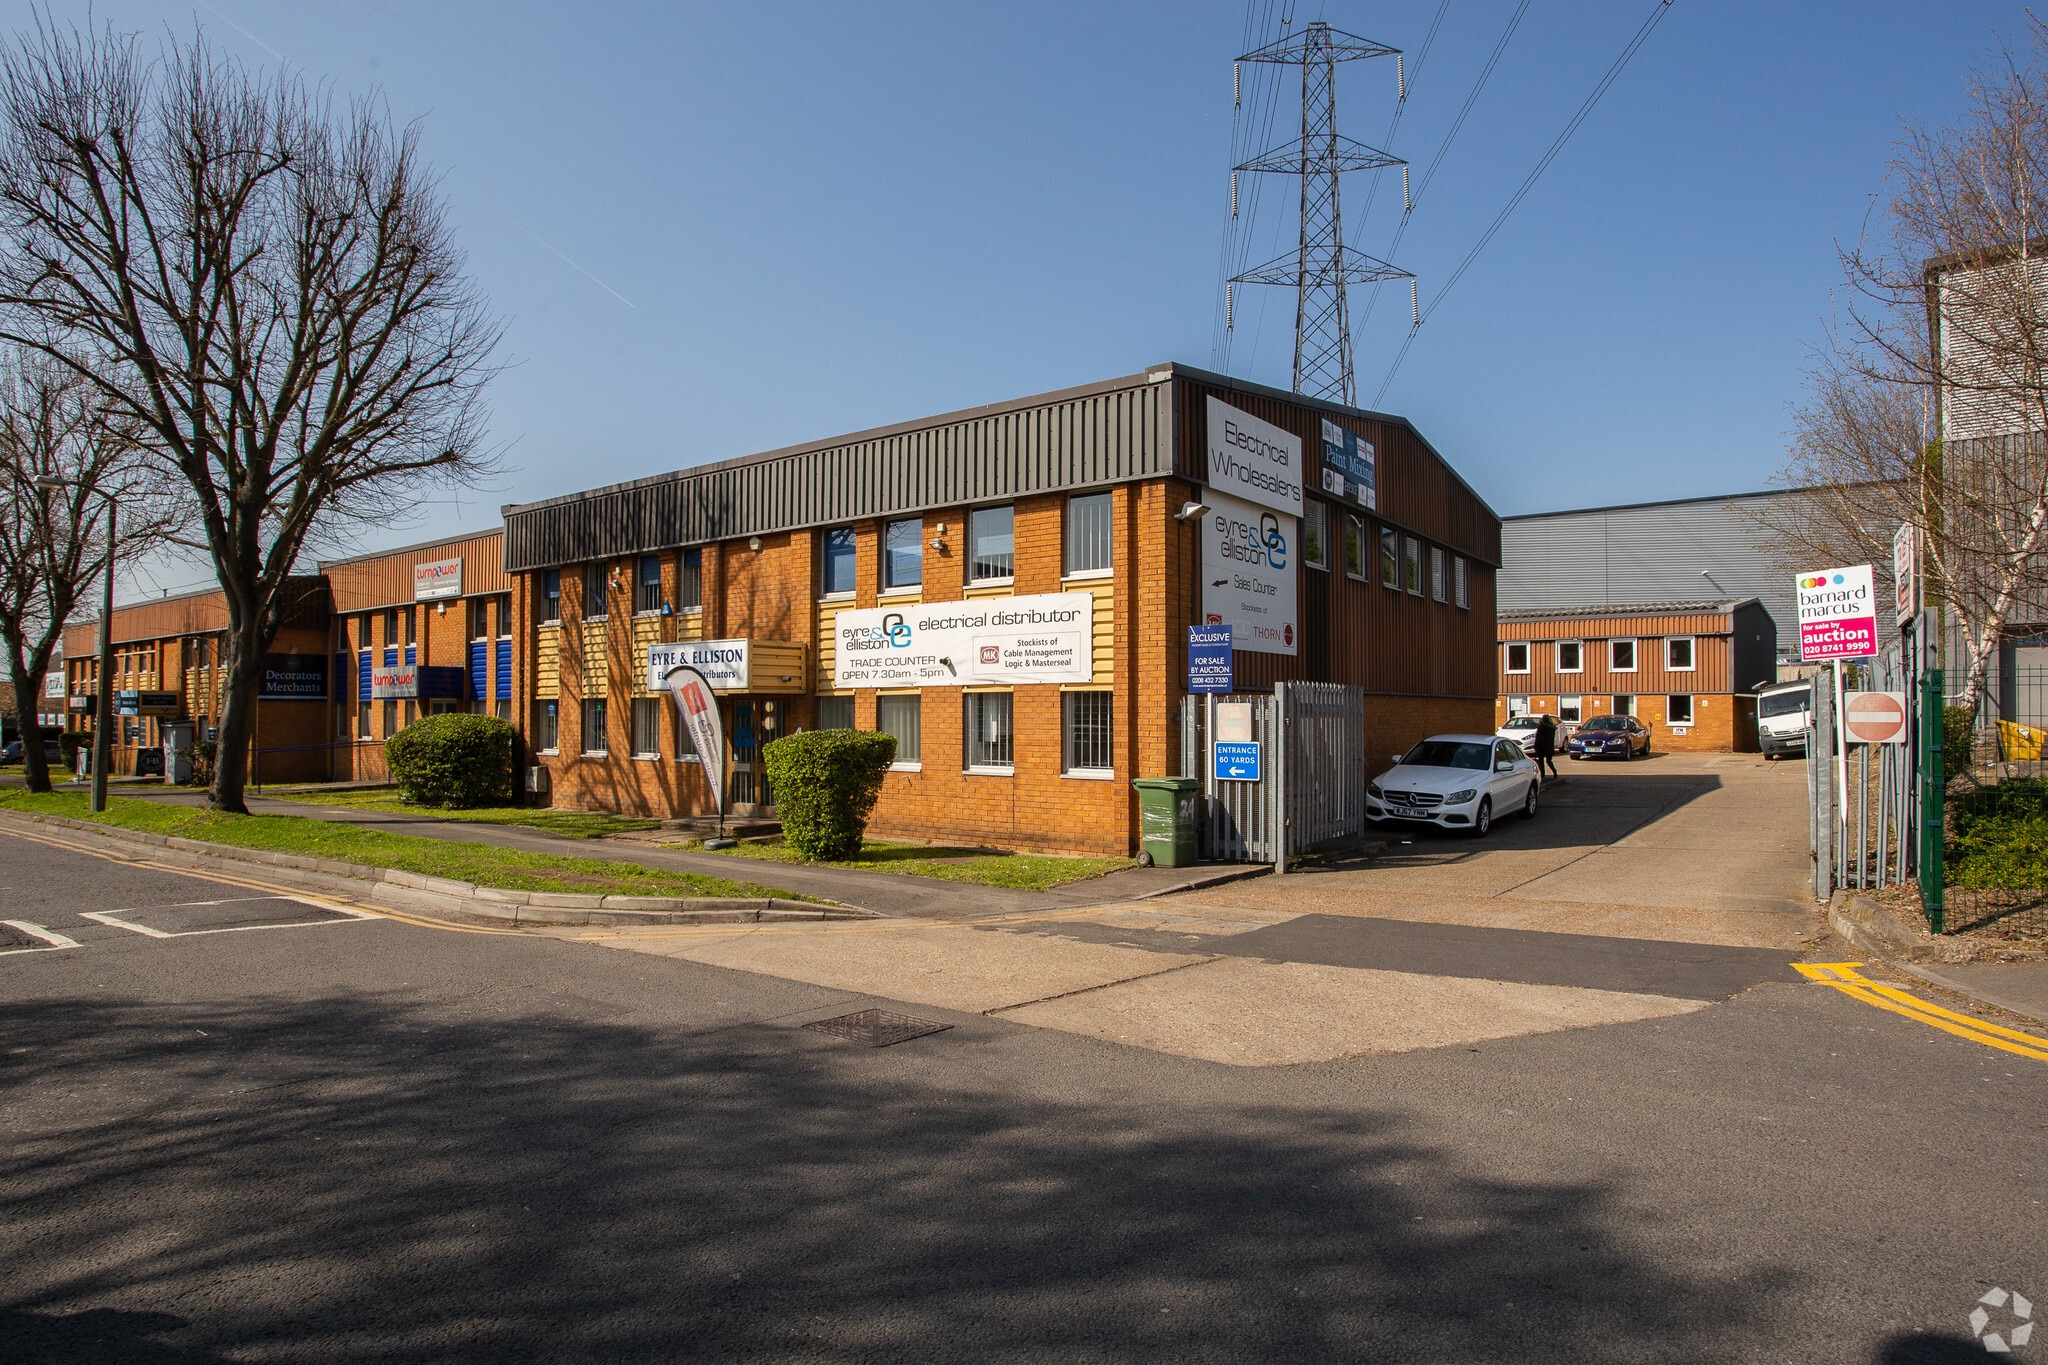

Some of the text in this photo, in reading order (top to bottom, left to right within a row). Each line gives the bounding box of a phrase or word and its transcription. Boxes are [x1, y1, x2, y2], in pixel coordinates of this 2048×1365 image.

[1225, 420, 1288, 467] Electrical
[1326, 444, 1346, 469] Paint
[1349, 456, 1373, 486] Mixing
[1211, 448, 1301, 501] Wholesalers
[1215, 516, 1262, 549] eyre &
[1221, 538, 1267, 567] elliston
[416, 563, 459, 580] turnpower
[1233, 574, 1277, 596] Sales Counter
[1800, 584, 1866, 606] barnard
[1241, 603, 1261, 613] Stockists
[1801, 602, 1860, 618] marcus
[919, 608, 1080, 631] electrical distributor
[842, 627, 885, 641] eyre &
[1190, 633, 1230, 642] EXCLUSIVE
[1253, 626, 1280, 641] THORN
[1803, 628, 1869, 644] auction
[846, 639, 890, 651] elliston
[1017, 637, 1058, 647] Stockists of
[1804, 642, 1870, 654] 020 8741 9990
[652, 648, 743, 666] EYRE & ELLISTON
[983, 651, 996, 660] MK
[1004, 648, 1073, 659] Cable Management
[849, 656, 936, 668] TRADE COUNTER
[1005, 659, 1023, 669] Logic
[1032, 658, 1072, 667] Masterseal
[266, 669, 322, 680] Decorators
[373, 673, 415, 688] turnpower
[702, 670, 736, 679] tributors
[842, 671, 869, 680] OPEN
[872, 670, 911, 679] 7.30am
[920, 668, 945, 679] 5pm
[266, 682, 321, 692] Merchants
